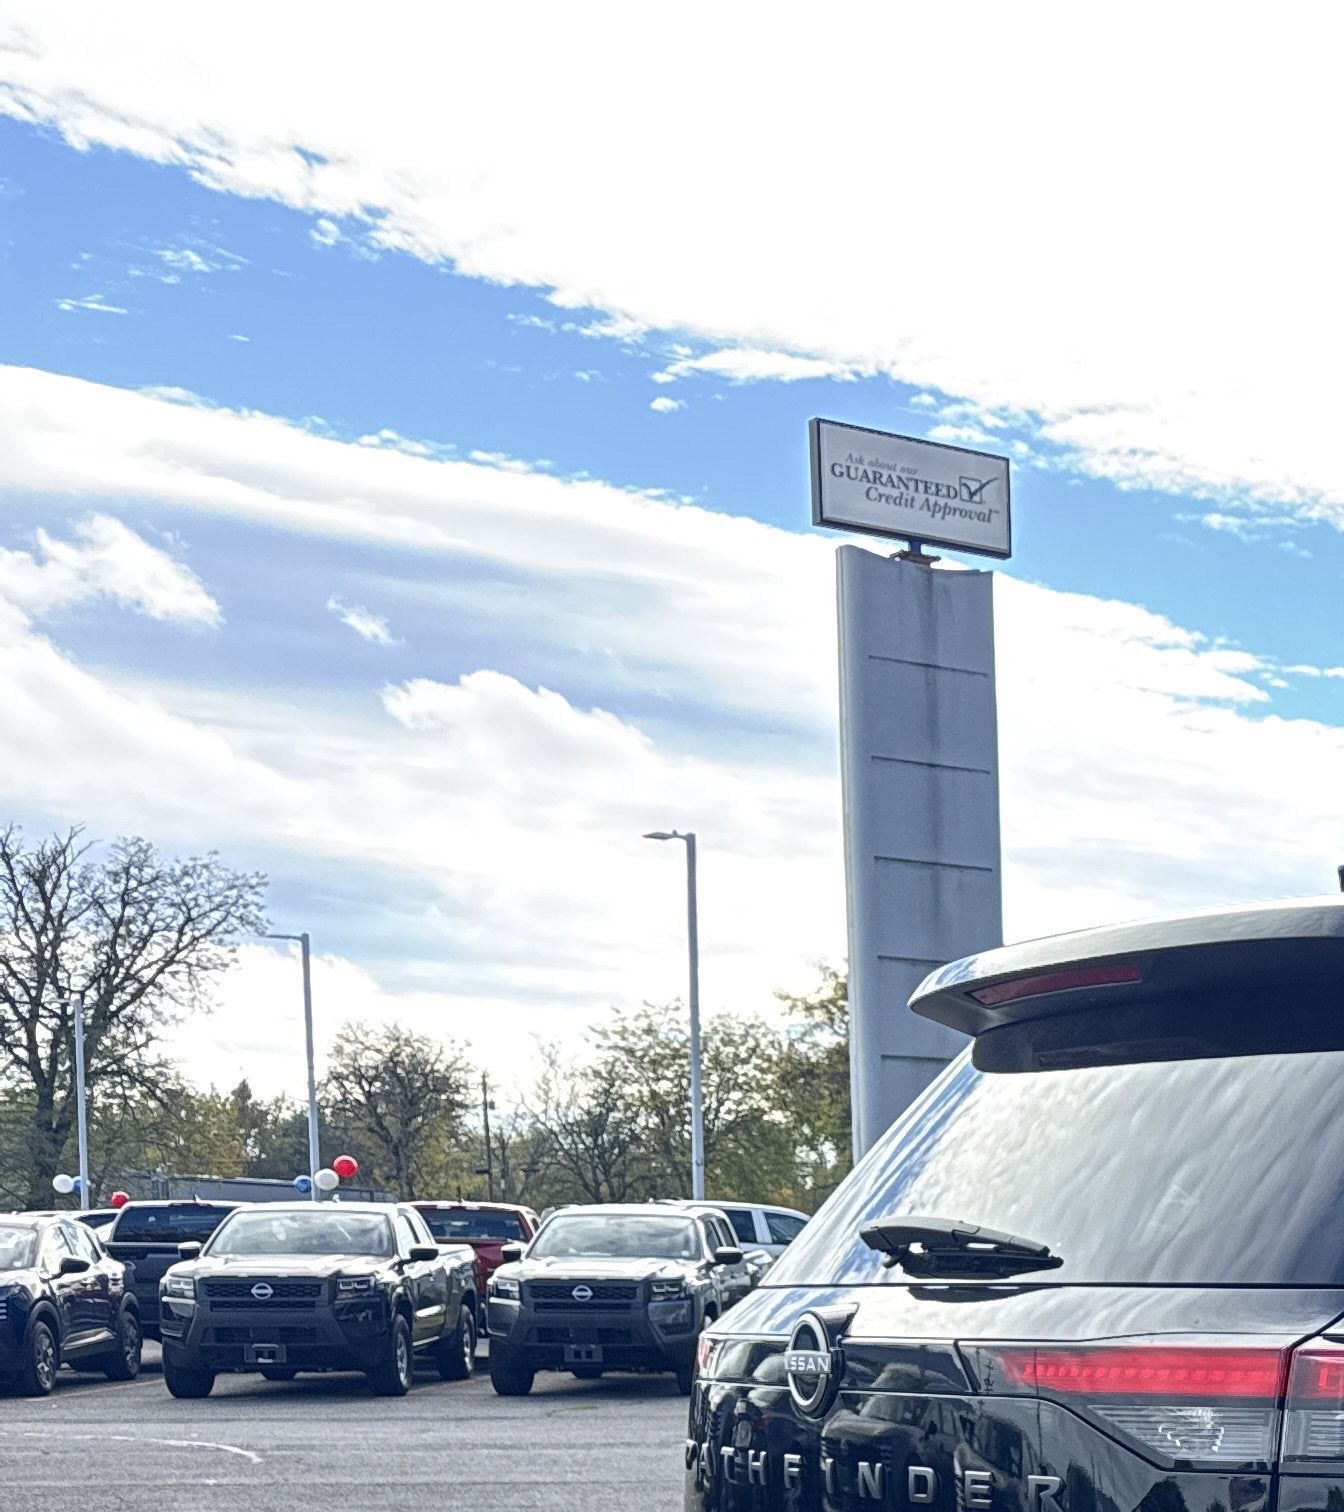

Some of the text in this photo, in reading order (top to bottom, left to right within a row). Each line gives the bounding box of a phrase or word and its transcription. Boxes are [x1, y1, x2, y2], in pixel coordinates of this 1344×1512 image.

[844, 453, 919, 475] Ask about our
[829, 462, 960, 500] GUARANTEED
[864, 486, 992, 524] Credit Approval
[786, 1356, 830, 1372] SSAN
